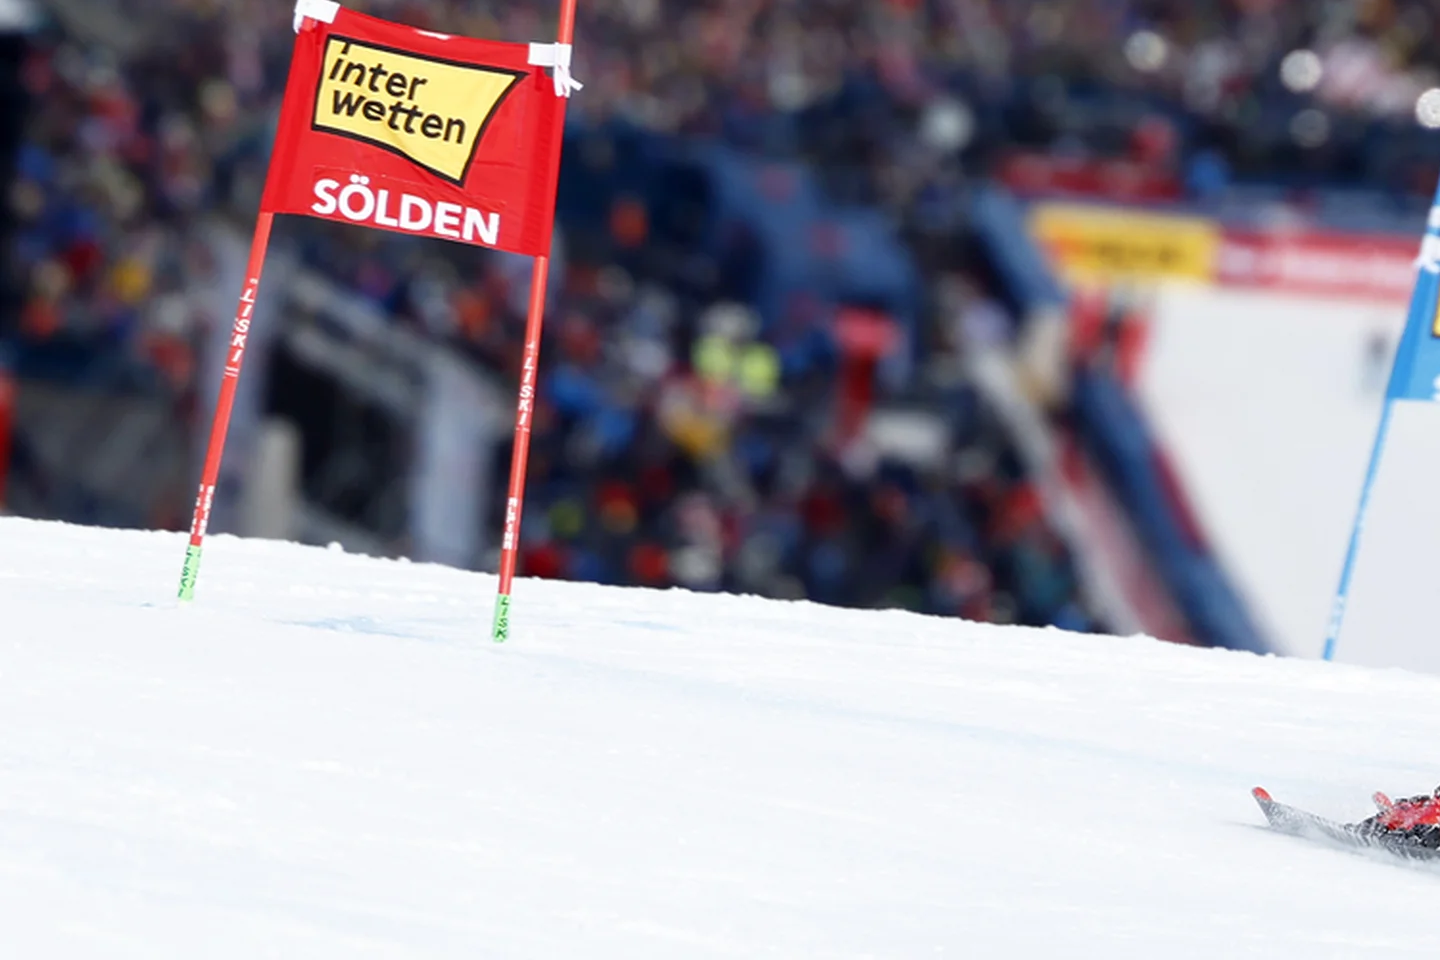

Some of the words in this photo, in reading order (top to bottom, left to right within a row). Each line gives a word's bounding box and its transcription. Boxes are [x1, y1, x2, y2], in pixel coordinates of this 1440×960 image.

[329, 41, 427, 100] inter
[333, 90, 466, 144] wetten
[312, 174, 500, 245] SÖLDEN
[231, 288, 254, 362] LISKI
[518, 356, 535, 425] LISKI
